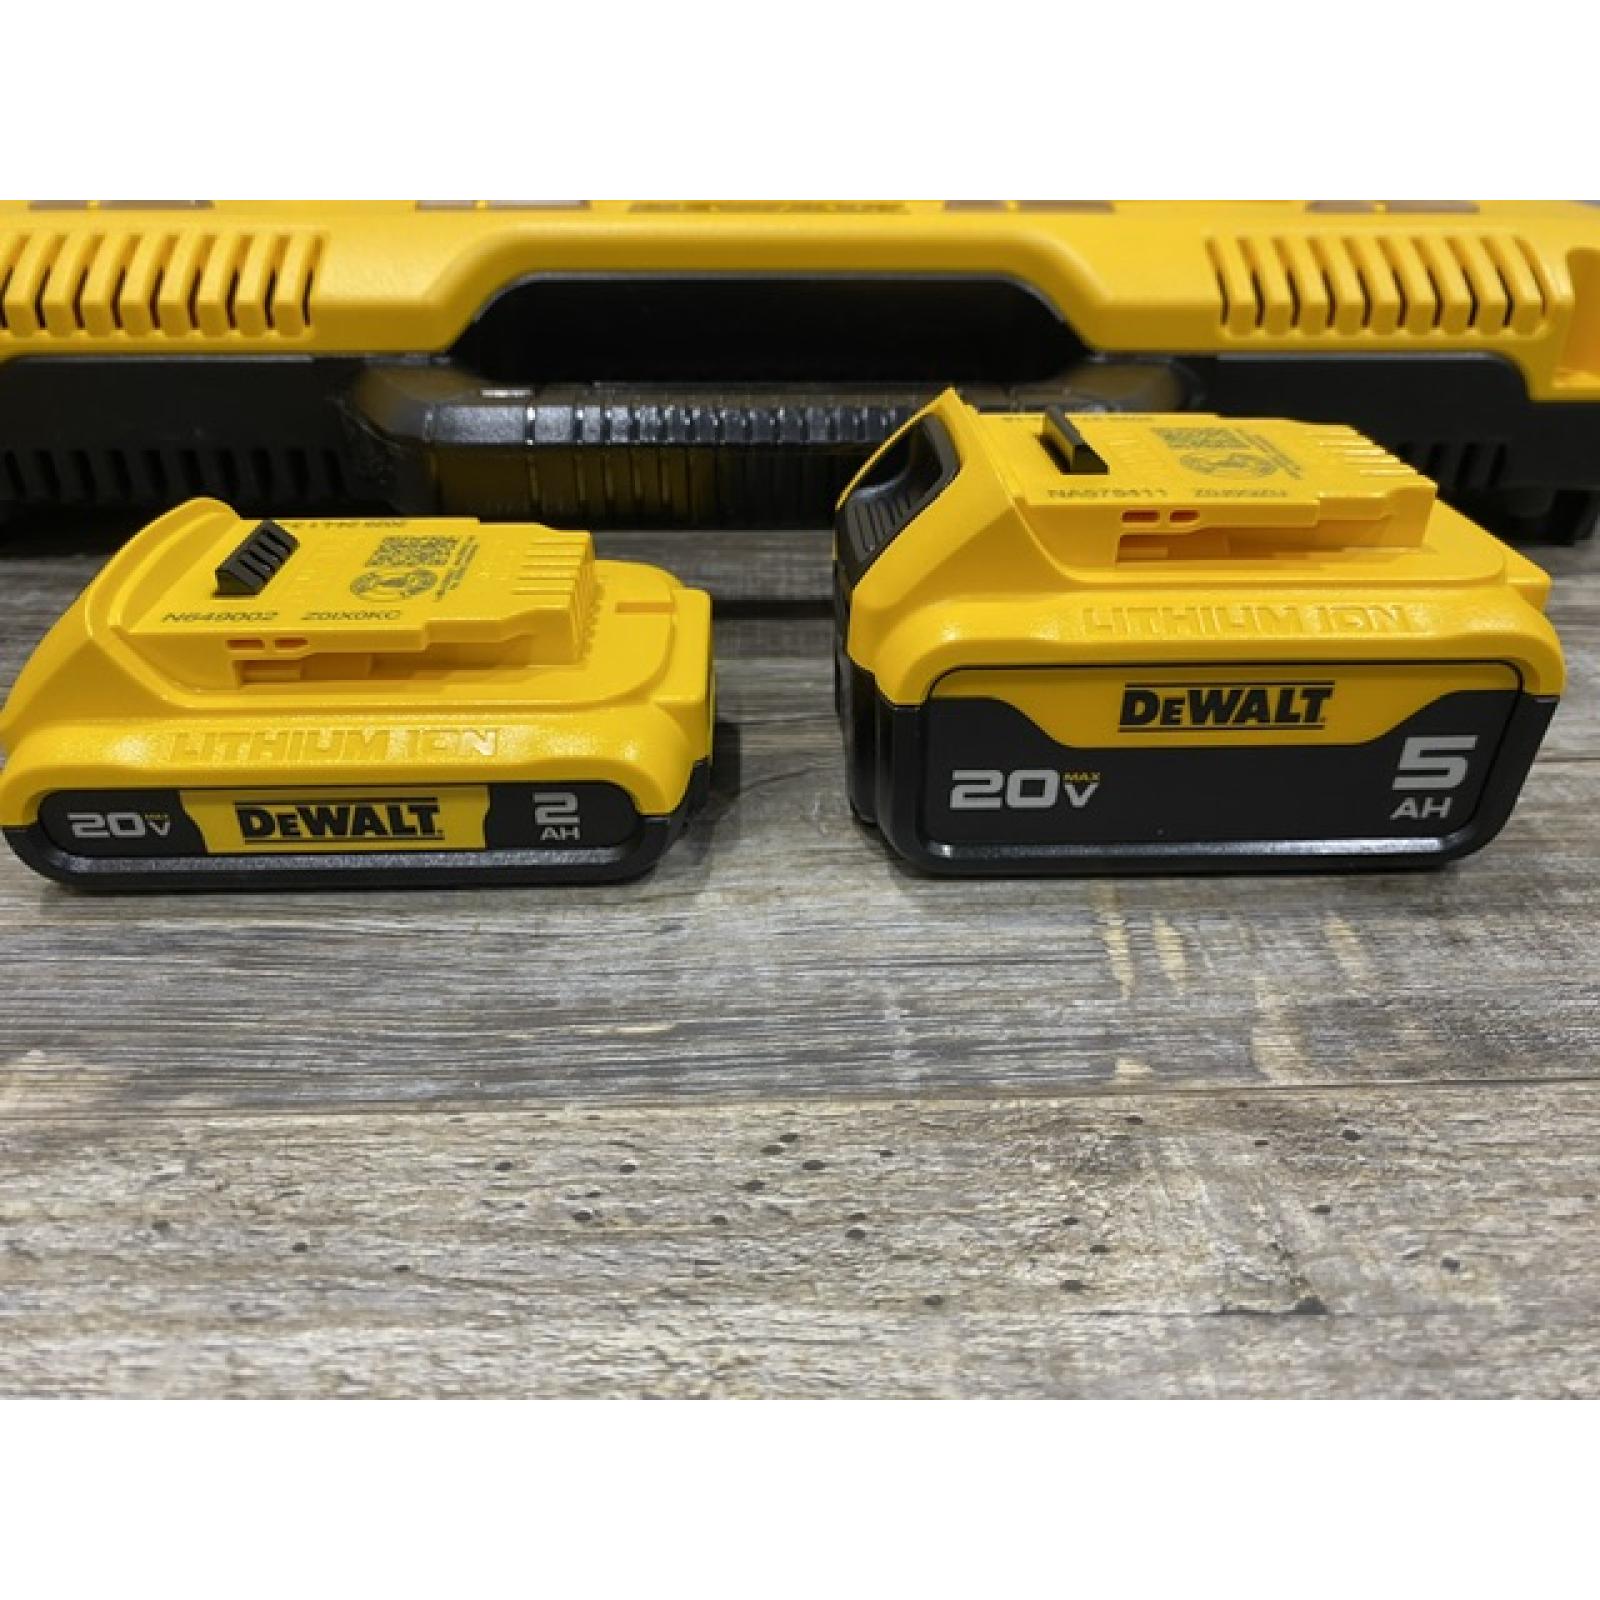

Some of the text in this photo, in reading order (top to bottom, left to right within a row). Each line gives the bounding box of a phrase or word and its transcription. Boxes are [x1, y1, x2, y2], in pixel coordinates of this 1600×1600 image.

[1082, 604, 1415, 636] LITHIUM ION
[1119, 686, 1333, 727] DEWALT
[170, 728, 498, 763] LITHIUM ION
[1392, 735, 1478, 791] 5
[237, 804, 442, 841] DEWALT
[532, 792, 580, 825] 2
[1390, 798, 1452, 820] AH
[540, 827, 581, 841] AH
